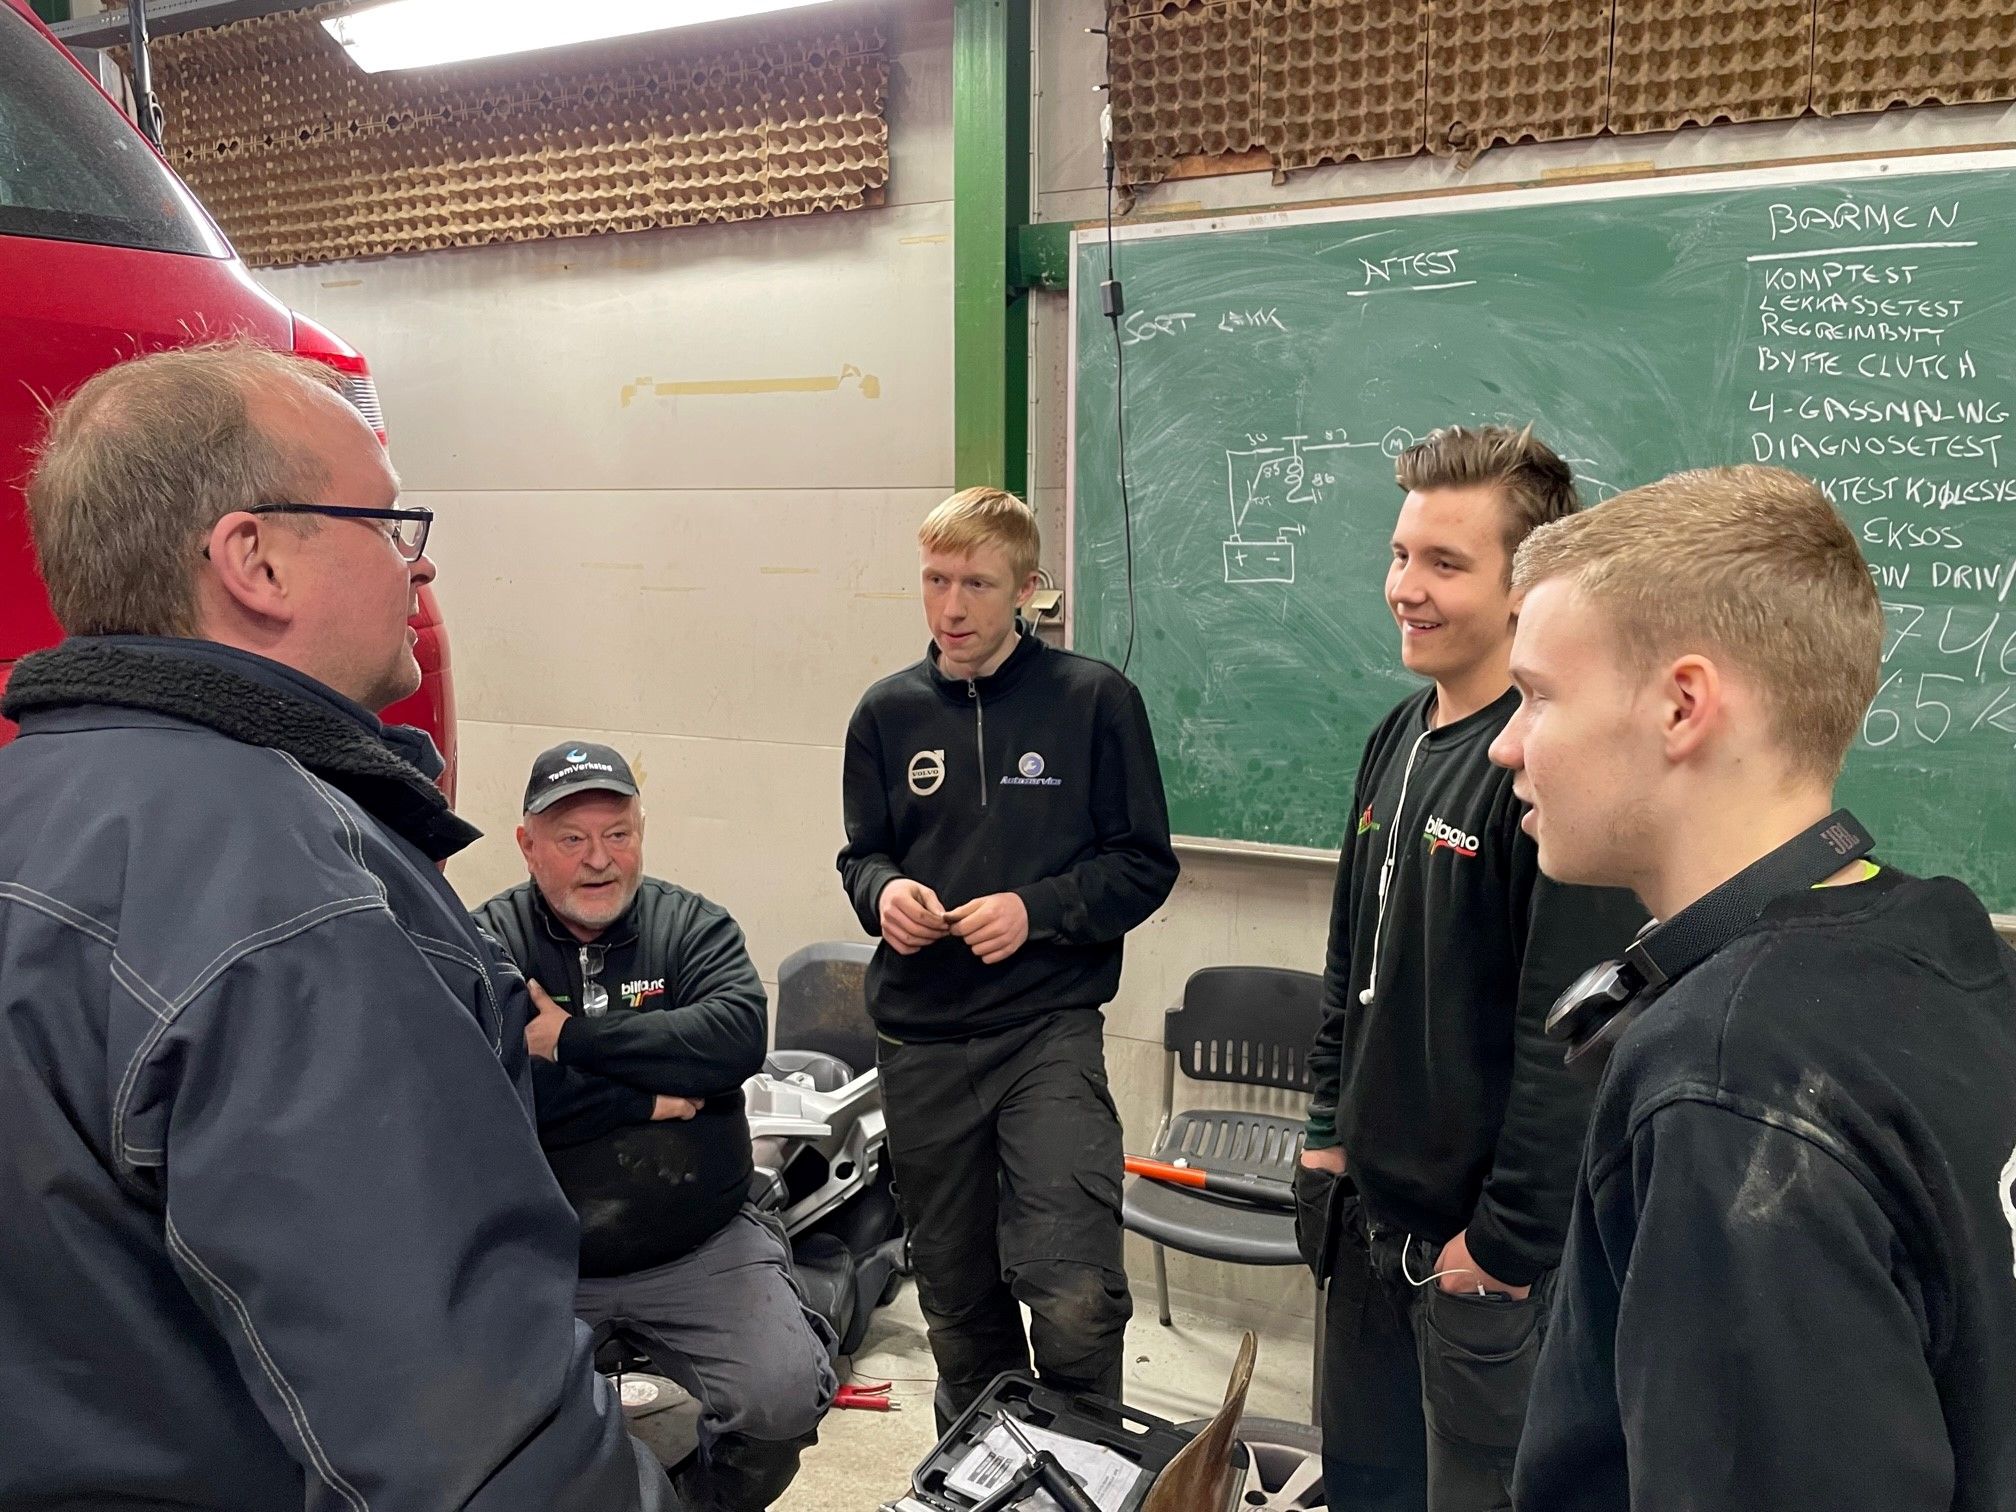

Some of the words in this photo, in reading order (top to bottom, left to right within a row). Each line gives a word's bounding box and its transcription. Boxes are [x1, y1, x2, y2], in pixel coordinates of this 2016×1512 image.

[1769, 202, 1960, 241] BARMEN
[1765, 262, 1919, 291] KOMPTEST
[1759, 292, 1964, 318] LEKKASJETEST
[1757, 345, 1843, 376] BYTTE
[1857, 349, 1977, 380] CLUTCH
[1751, 432, 2003, 468] DIAGNOSETEST
[1811, 476, 1900, 505] KTEST
[1863, 516, 1963, 550] EKSOS
[912, 769, 939, 777] VOLVO
